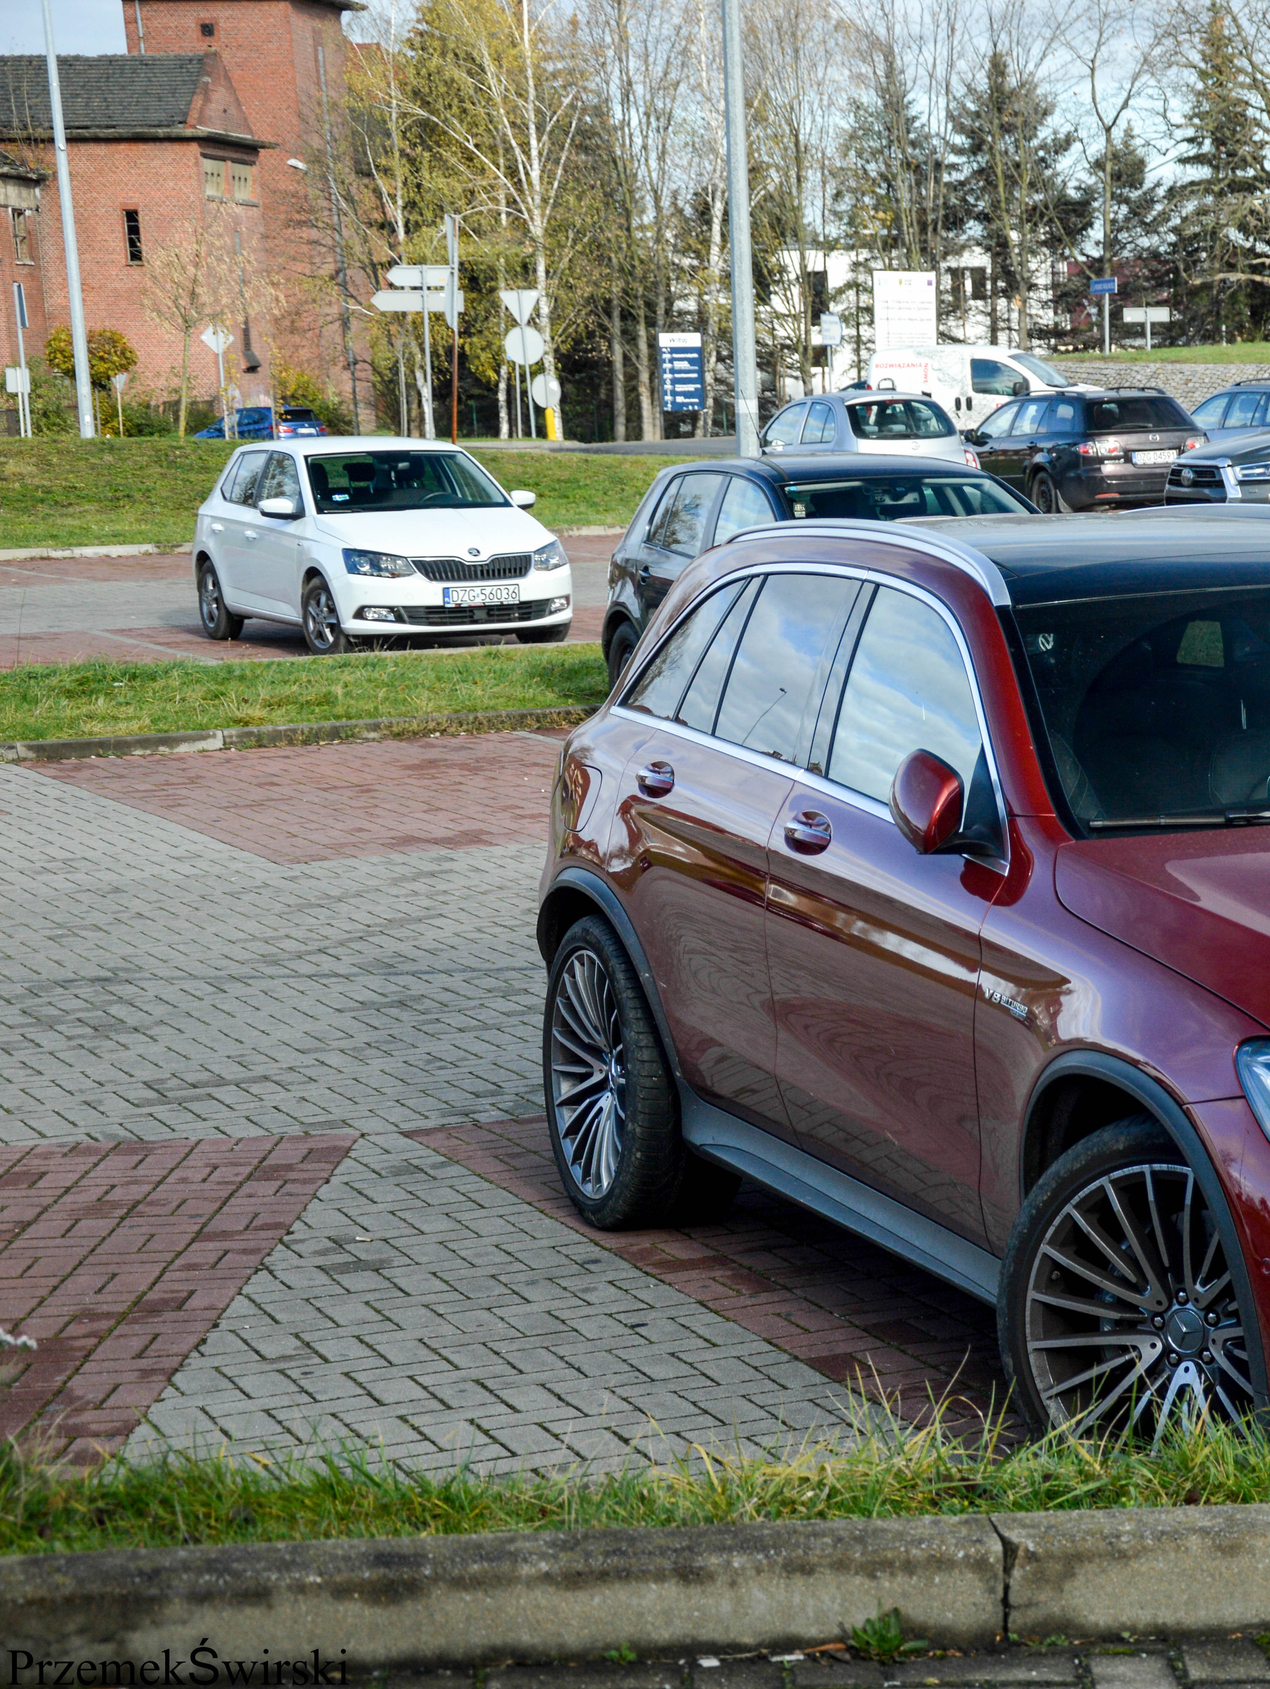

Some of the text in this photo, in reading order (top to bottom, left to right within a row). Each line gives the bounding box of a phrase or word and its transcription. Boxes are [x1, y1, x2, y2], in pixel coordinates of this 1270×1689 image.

[1136, 453, 1152, 463] DZG
[1153, 451, 1176, 462] 04591
[451, 586, 518, 603] DZG 56036
[985, 987, 1028, 1014] V8 BITURBO
